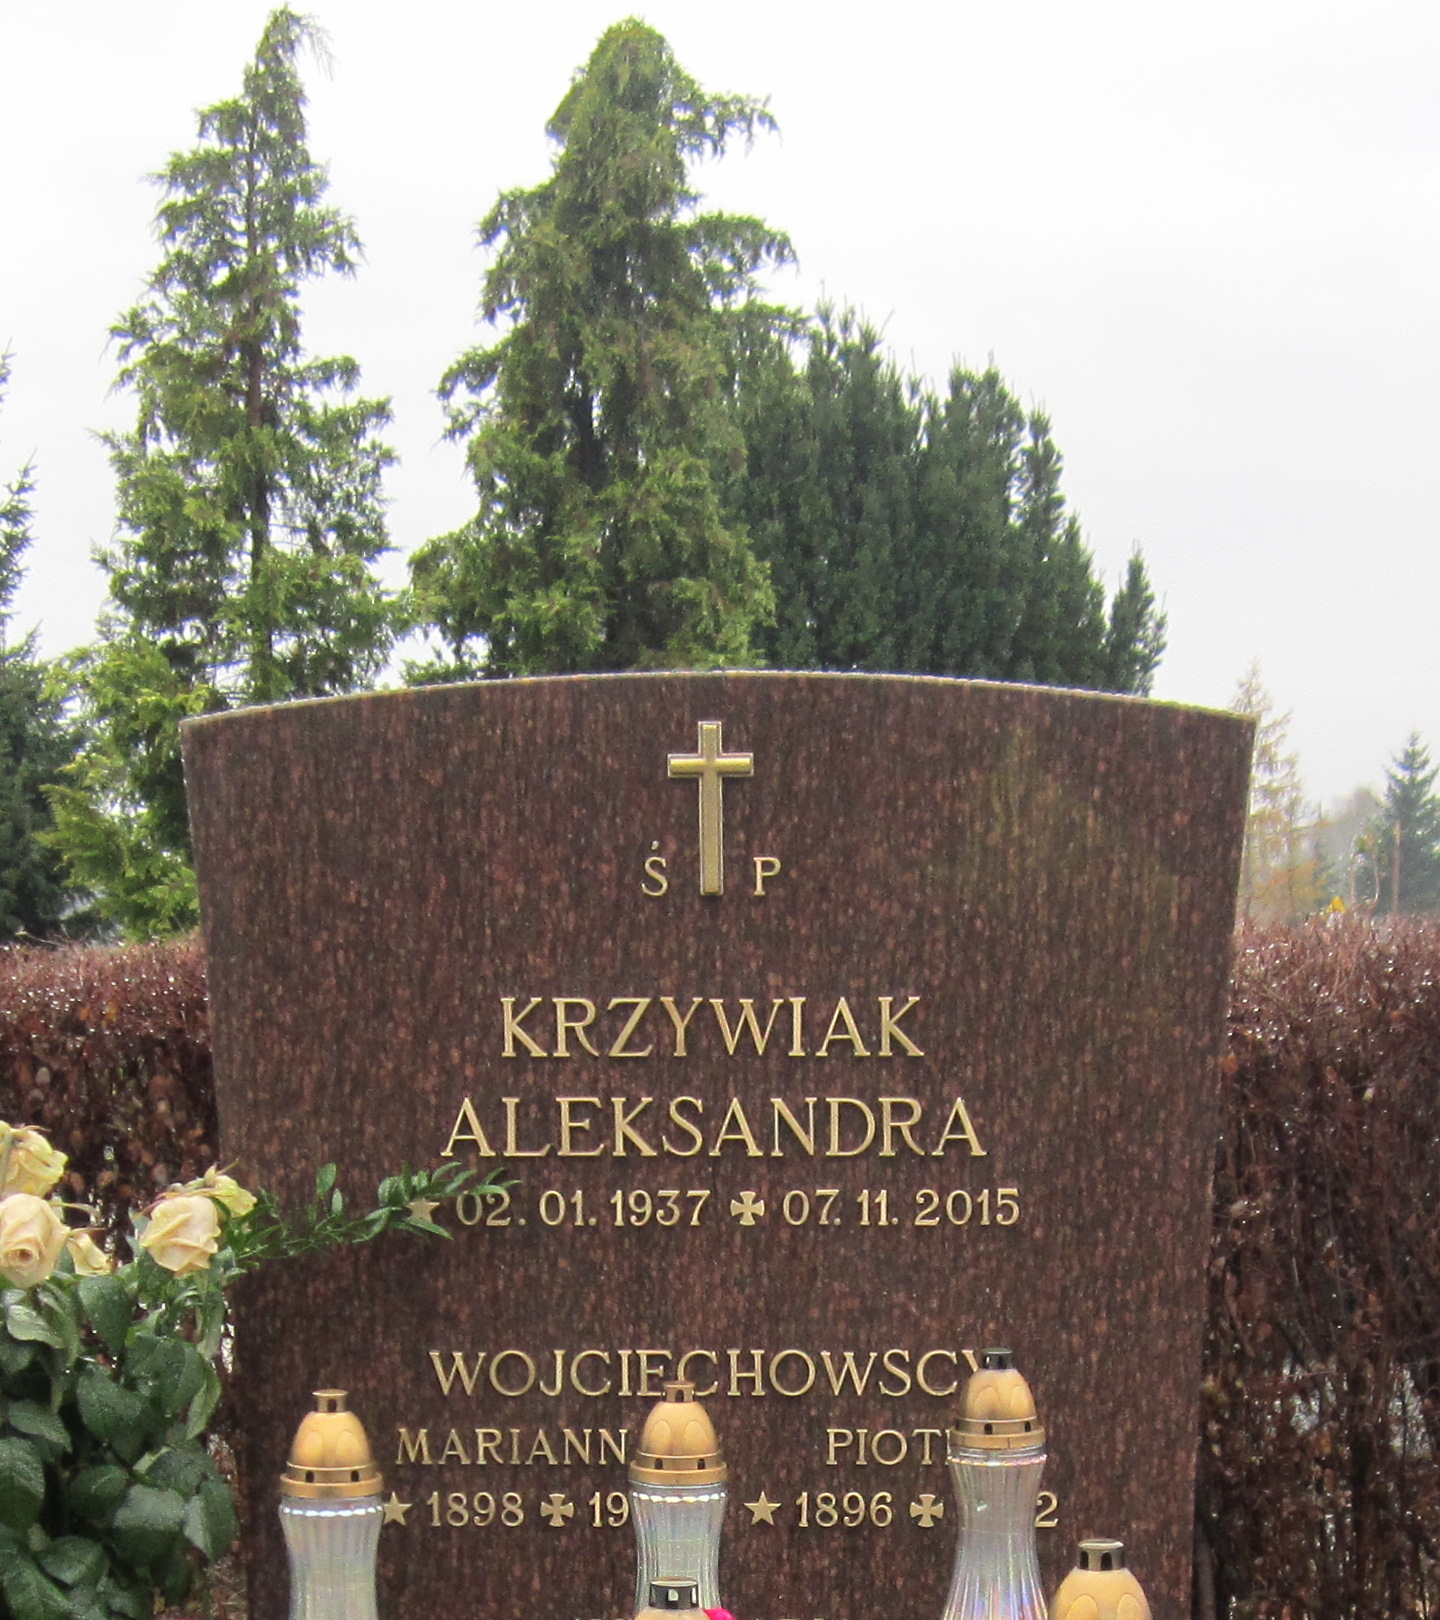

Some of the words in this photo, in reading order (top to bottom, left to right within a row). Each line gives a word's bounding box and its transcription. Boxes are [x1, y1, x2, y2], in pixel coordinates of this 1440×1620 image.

[752, 856, 782, 897] P
[500, 996, 925, 1058] KRZYWIAK
[440, 1096, 988, 1158] ALEKSANDRA
[395, 1428, 629, 1465] MARIANN
[825, 1428, 953, 1466] PIOT
[427, 1491, 525, 1528] 1898
[795, 1491, 893, 1528] 1896
